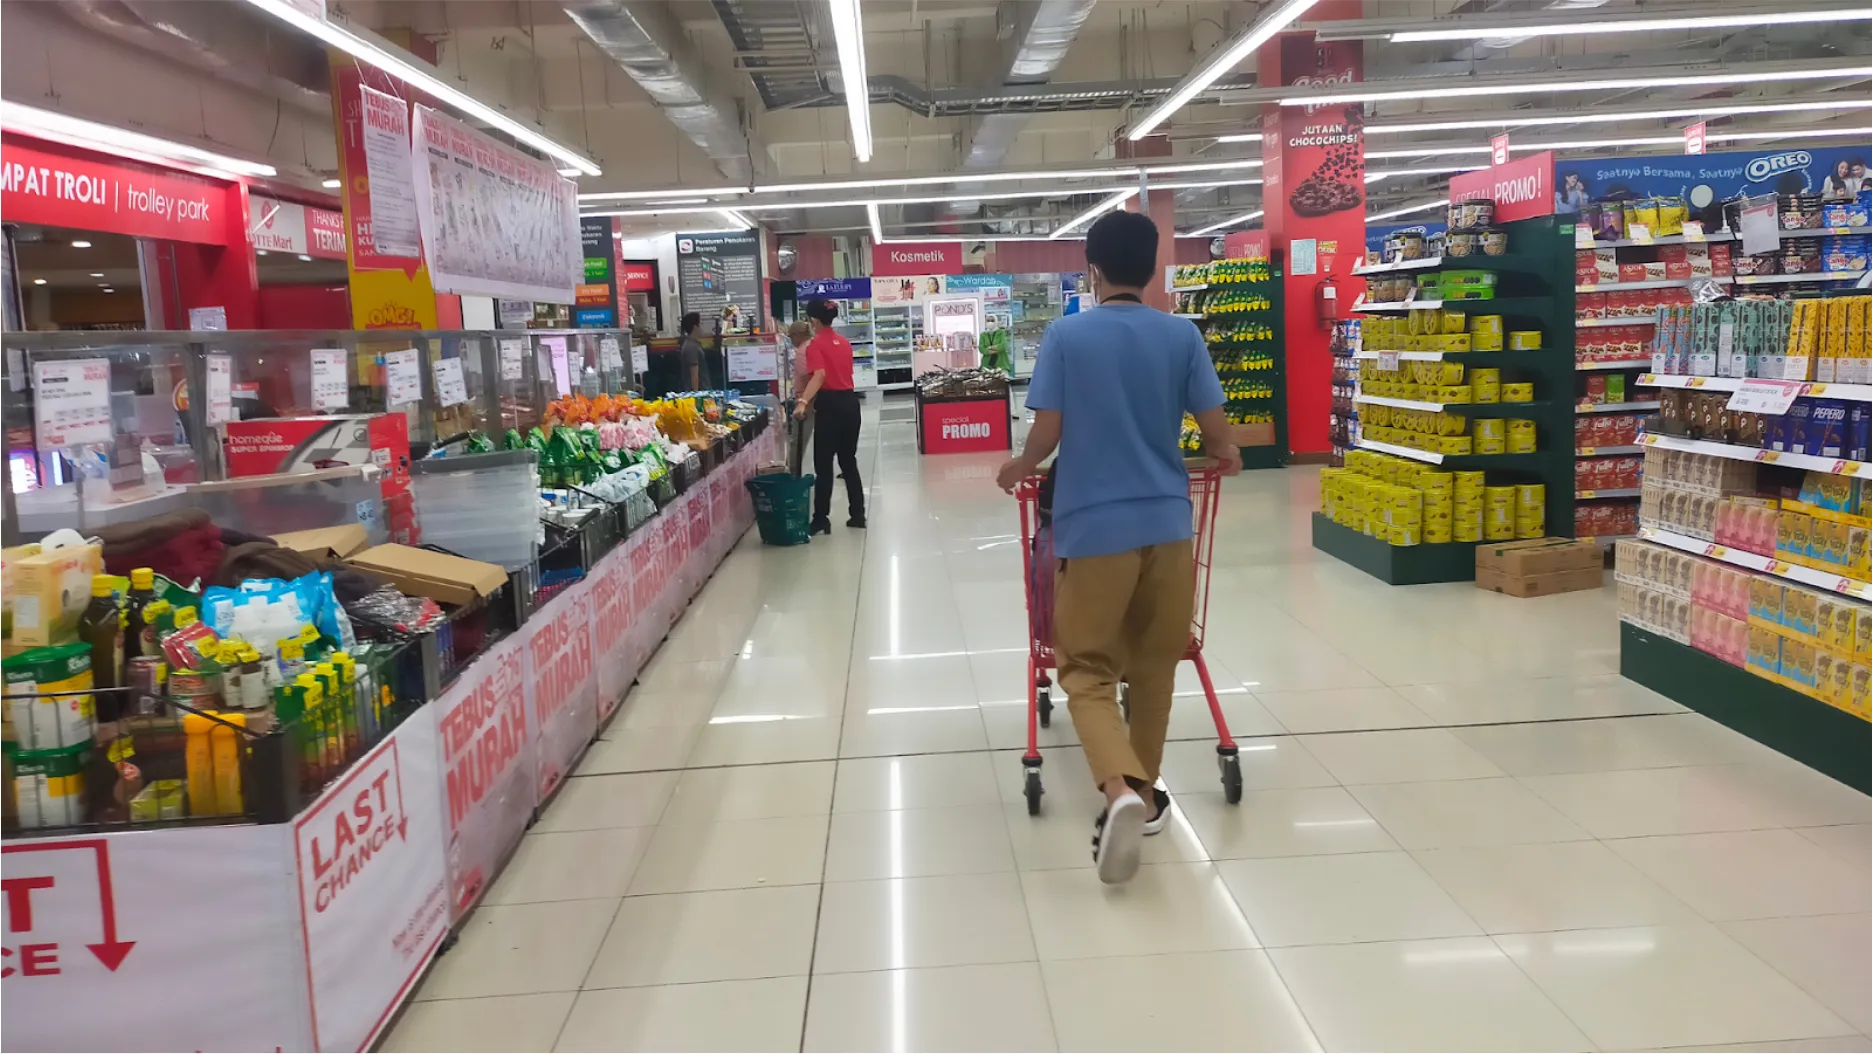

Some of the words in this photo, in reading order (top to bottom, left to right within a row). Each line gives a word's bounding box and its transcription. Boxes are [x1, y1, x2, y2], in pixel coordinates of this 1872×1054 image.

[366, 93, 390, 112] TEBUS
[367, 108, 405, 136] MURAH
[1302, 124, 1342, 135] JUTAAN
[1597, 168, 1640, 180] Saatnya
[1643, 166, 1695, 180] Bersama,
[1699, 167, 1743, 180] Saatnya
[1749, 153, 1809, 177] OREO
[1, 160, 50, 197] MPAT
[55, 172, 106, 205] TROLI
[127, 183, 175, 220] trolley
[177, 197, 210, 222] park
[1494, 167, 1542, 205] PROMO!
[312, 209, 339, 228] THANKS
[273, 234, 293, 250] Mart
[313, 227, 346, 253] TERIM
[358, 236, 374, 246] KU
[891, 250, 944, 263] Kosmetik
[934, 304, 974, 315] POND'S
[942, 416, 970, 425] special
[1812, 407, 1846, 420] PEPERO
[942, 422, 991, 439] PROMO
[530, 610, 569, 669] TEBUS
[535, 632, 592, 729] MURAH
[440, 674, 495, 763] TEBUS
[447, 695, 527, 830] MURAH
[312, 769, 389, 881] LAST
[315, 814, 394, 913] CHANCE
